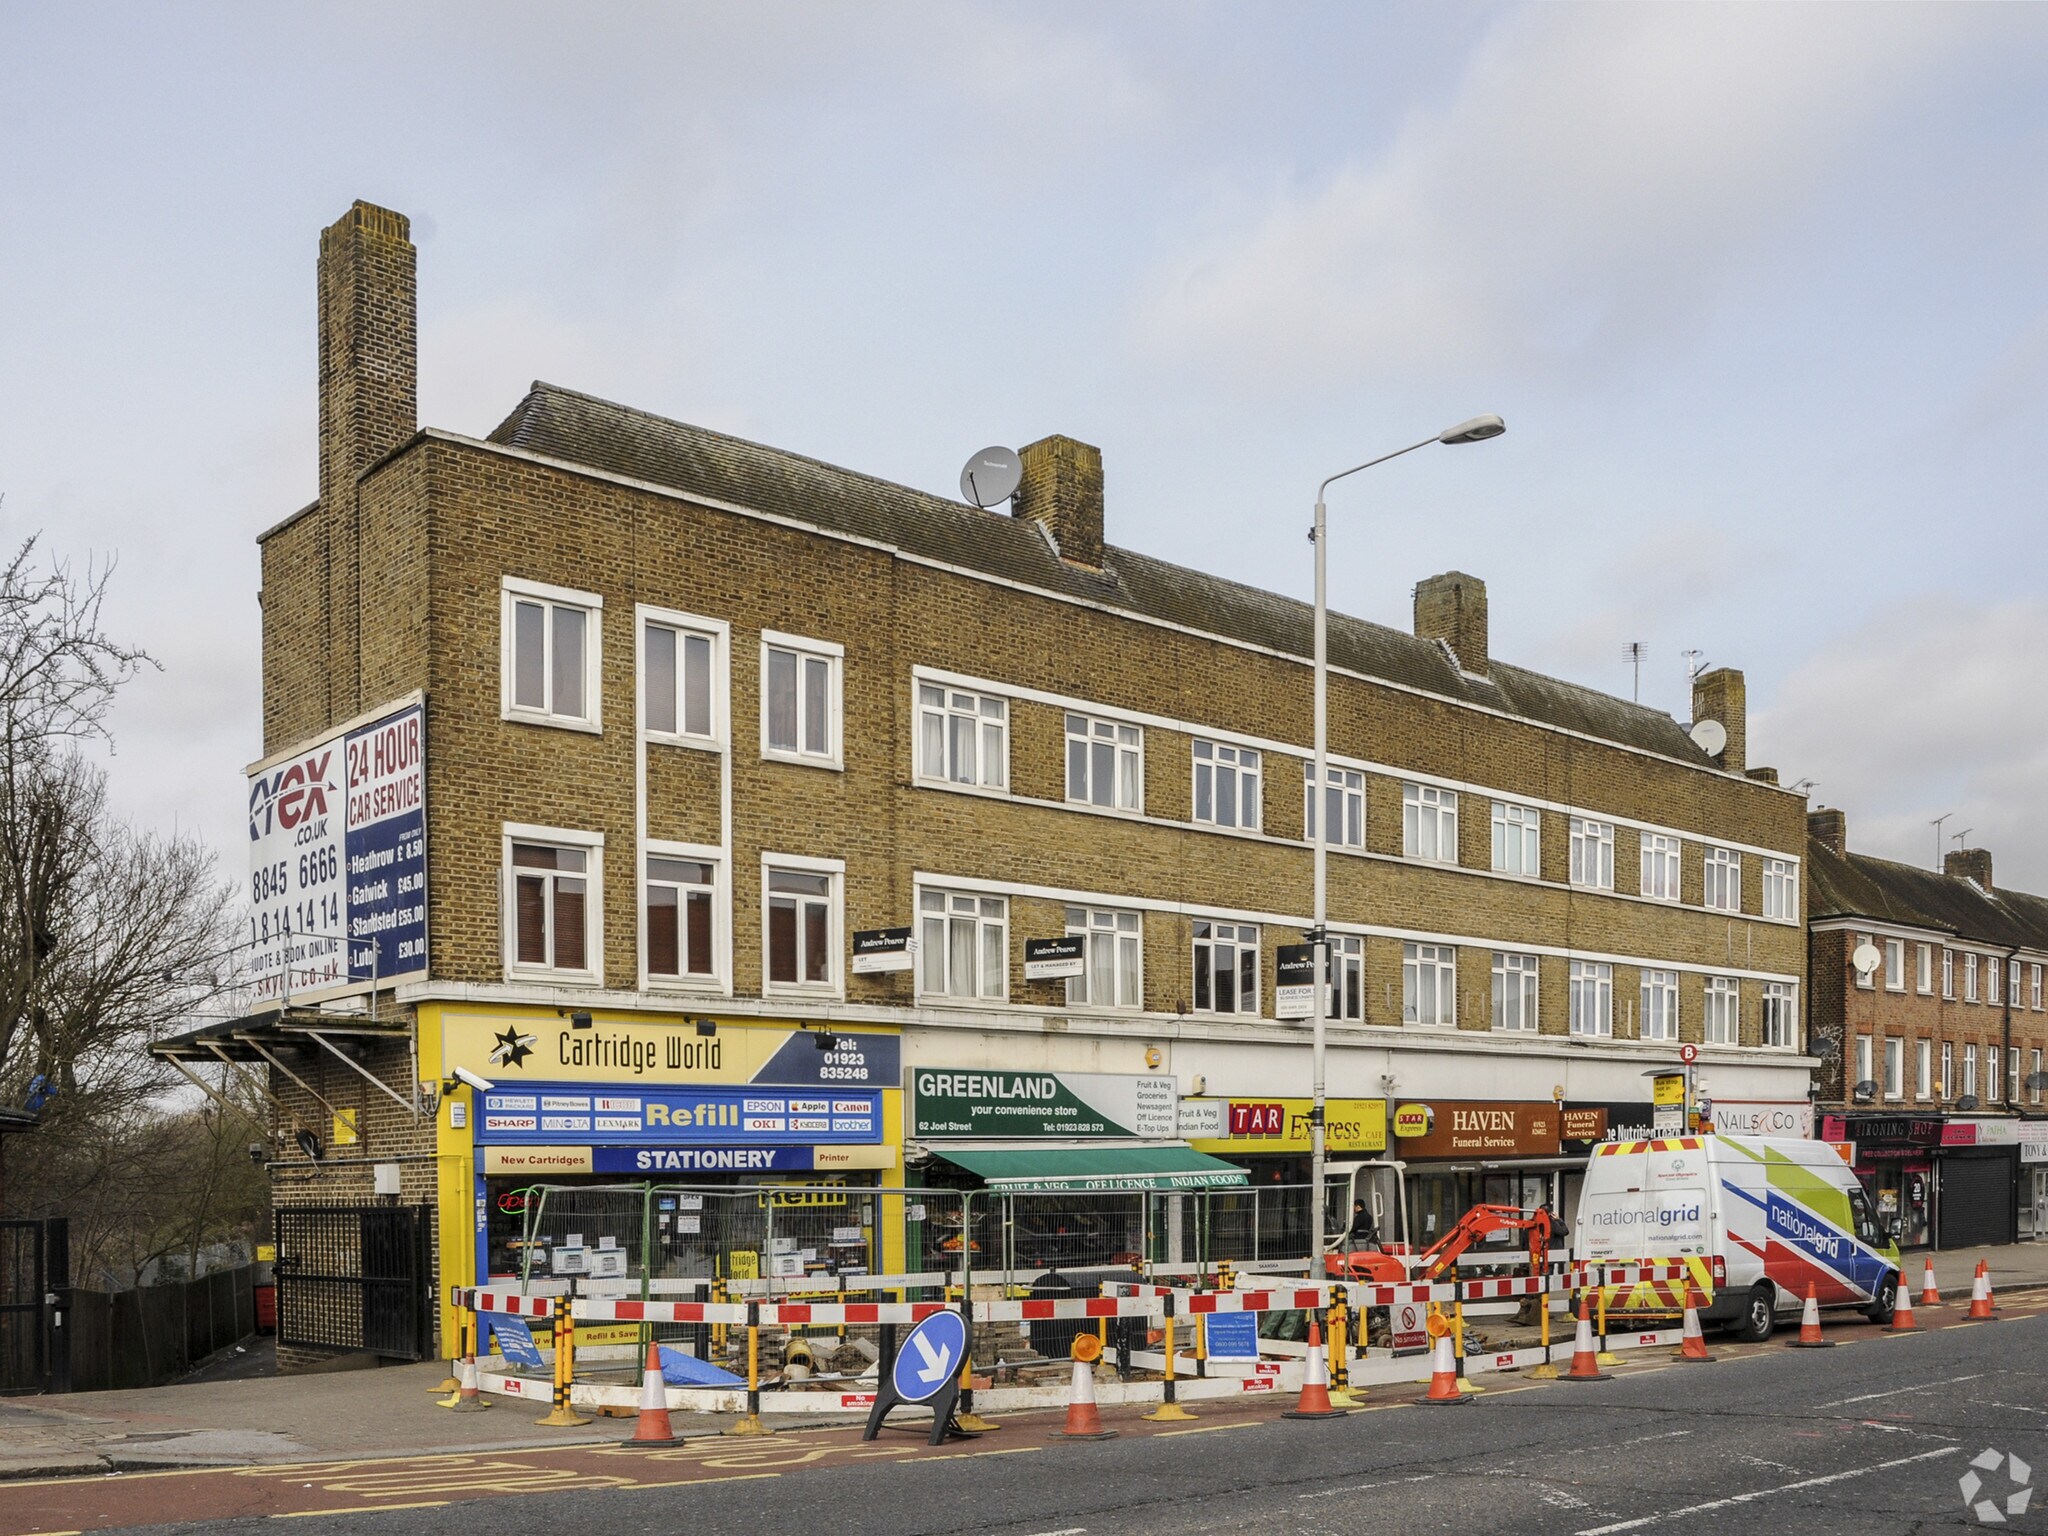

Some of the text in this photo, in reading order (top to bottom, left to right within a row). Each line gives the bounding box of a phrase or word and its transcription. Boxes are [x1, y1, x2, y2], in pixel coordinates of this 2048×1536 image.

[349, 718, 419, 787] 24 HOUR
[349, 773, 419, 826] CAR SERVICE
[295, 818, 328, 847] .CO.UK
[399, 827, 421, 841] FROM ONLY
[352, 839, 422, 874] Heathrow £ 8.50
[254, 845, 337, 904] 8845 6666
[352, 872, 423, 905] Gatwick £45.00
[398, 905, 423, 926] £55.00
[861, 937, 904, 947] Andrew Pearce
[252, 953, 272, 973] UOTE
[276, 951, 281, 966] &
[309, 937, 338, 958] ONLINE
[354, 938, 424, 968] Luto £30.00
[1033, 946, 1076, 955] Andrew Pearce
[1280, 962, 1306, 970] Andrew
[834, 1039, 857, 1050] Tel:
[559, 1032, 721, 1074] Cartridge World
[824, 1053, 864, 1064] 01923
[1685, 1047, 1693, 1059] B
[820, 1067, 868, 1080] 835248
[919, 1074, 1056, 1099] GREENLAND
[1137, 1081, 1151, 1089] Fruit
[1137, 1092, 1167, 1100] Groceries
[747, 1102, 781, 1112] EPSON
[802, 1102, 826, 1111] Apple
[835, 1103, 869, 1112] Canon
[972, 1105, 1077, 1116] your convenience store
[1137, 1103, 1172, 1111] Newsagent
[647, 1103, 738, 1126] Refill
[1179, 1109, 1216, 1119] Fruit & Veg
[1236, 1108, 1278, 1129] TAR
[1399, 1114, 1423, 1123] STAR
[1564, 1112, 1598, 1121] HAVEN
[488, 1119, 534, 1127] SHARP
[543, 1119, 588, 1128] MINOLTA
[597, 1119, 639, 1129] LEXMARK
[753, 1120, 776, 1128] OKI
[800, 1121, 826, 1129] KYOCERA
[834, 1120, 869, 1129] brother
[1453, 1111, 1514, 1130] HAVEN
[1717, 1111, 1759, 1129] NAILS
[919, 1122, 972, 1131] 62 Joel Street
[1043, 1123, 1104, 1132] Tel: 01923 828 573
[1137, 1124, 1169, 1133] E-Top Ups
[1177, 1122, 1218, 1131] Indian Food
[1289, 1115, 1360, 1140] Exress
[1861, 1122, 1904, 1136] IRONING
[1908, 1122, 1933, 1135] SHOP
[1366, 1131, 1382, 1139] CAFE
[1566, 1129, 1595, 1137] Services
[1618, 1124, 1655, 1141] Nutrition
[1453, 1137, 1515, 1147] Funeral Services
[501, 1156, 585, 1165] New Cartridges
[637, 1150, 776, 1169] STATIONERY
[819, 1154, 849, 1162] Printer
[1044, 1181, 1069, 1191] VEG
[1086, 1179, 1108, 1190] OFF
[1109, 1178, 1156, 1189] LICENCE
[1171, 1175, 1208, 1187] INDIAN
[1210, 1174, 1243, 1185] FOODS
[1914, 1183, 1920, 1192] 20
[761, 1182, 843, 1204] Refill
[497, 1193, 541, 1209] Open
[1593, 1204, 1699, 1226] nationalgrid
[1772, 1205, 1839, 1259] nationalgrid
[1648, 1234, 1703, 1242] nationalgrid.com
[732, 1254, 755, 1266] tridge
[731, 1269, 749, 1279] orld
[619, 1330, 638, 1338] Save
[1404, 1335, 1425, 1343] smoking
[588, 1434, 919, 1469] BUS
[233, 1457, 637, 1498] STOP
